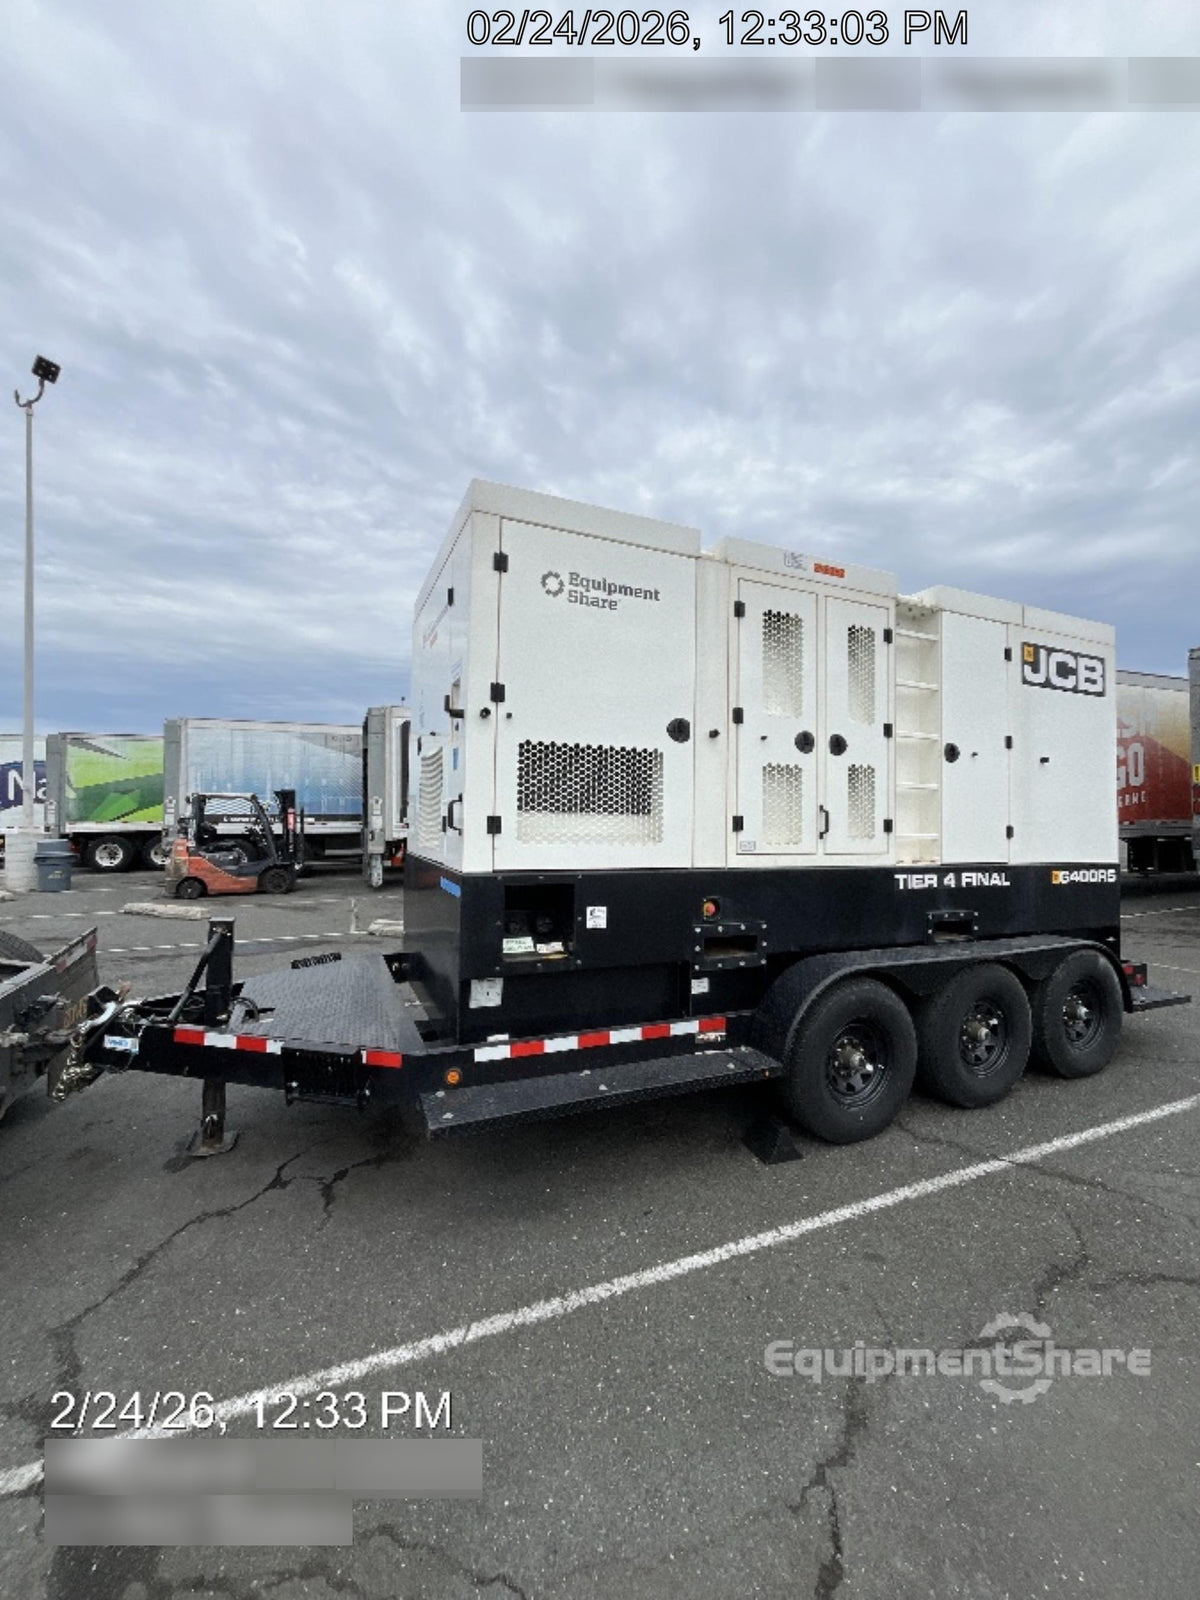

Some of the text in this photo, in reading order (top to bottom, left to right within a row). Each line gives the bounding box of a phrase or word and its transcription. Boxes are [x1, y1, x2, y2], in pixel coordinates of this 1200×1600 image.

[568, 572, 661, 602] Equipment
[567, 590, 619, 611] Share
[1022, 646, 1104, 694] JCB
[894, 872, 1011, 890] TIER 4 FINAL
